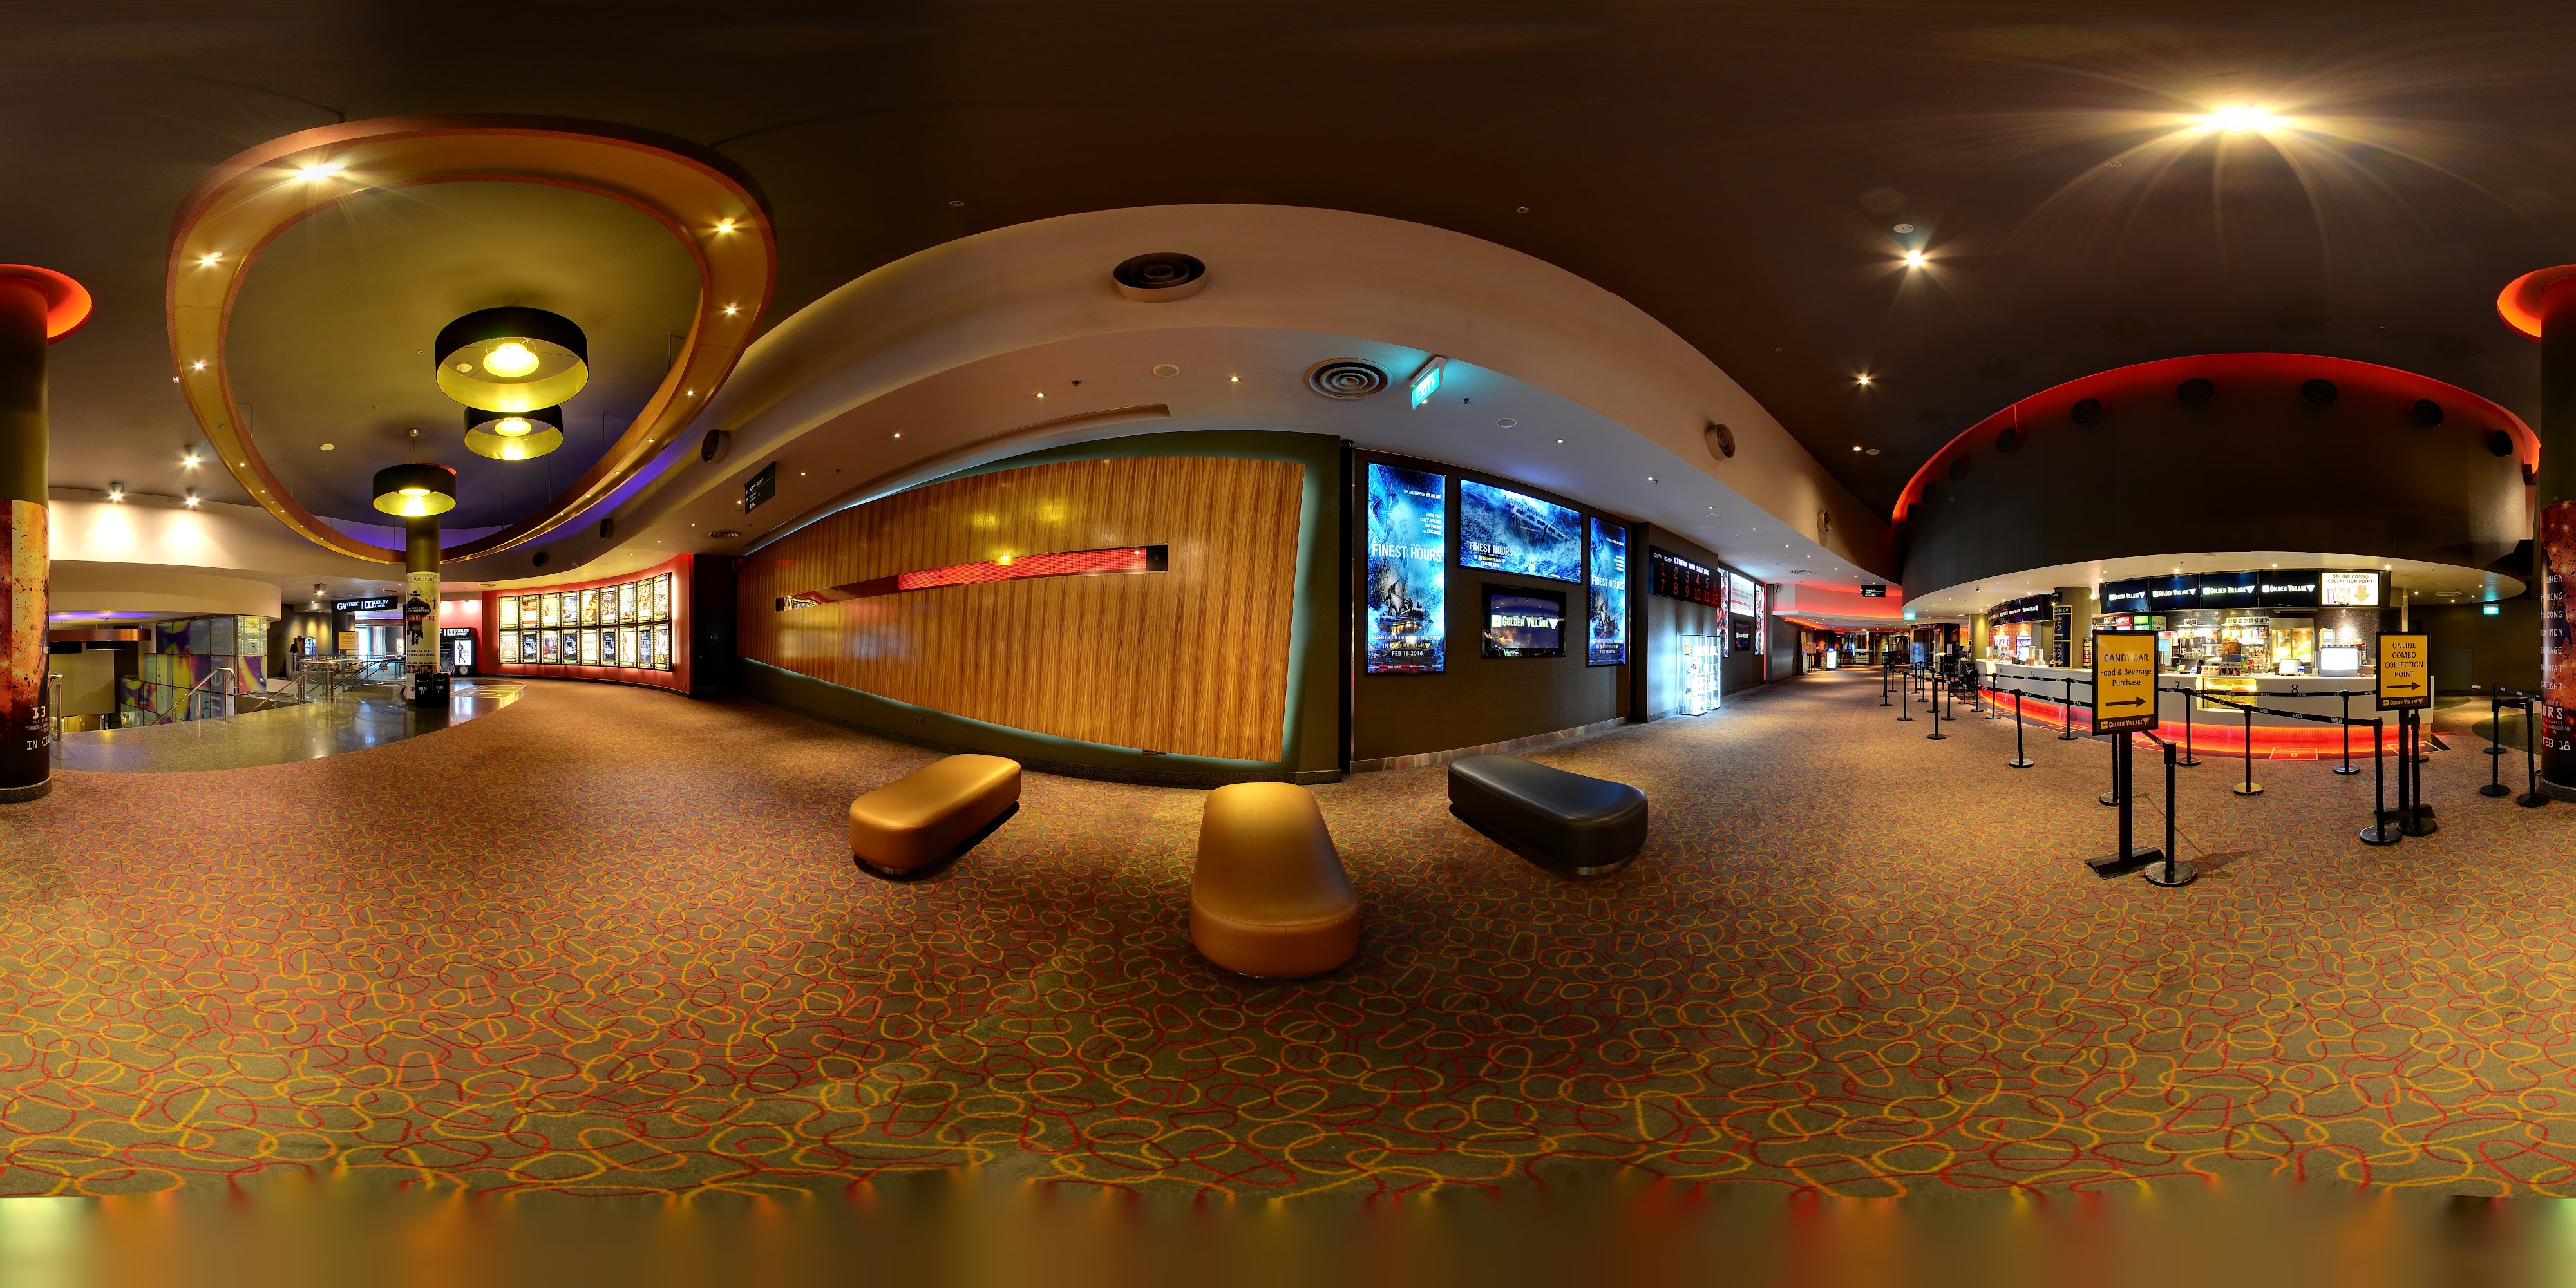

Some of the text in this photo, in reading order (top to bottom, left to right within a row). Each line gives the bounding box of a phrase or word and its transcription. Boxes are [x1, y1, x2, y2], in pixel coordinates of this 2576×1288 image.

[1416, 379, 1430, 402] EXIT
[1372, 543, 1442, 562] FINEST HOURS
[1470, 541, 1513, 556] FINEST HOURS
[1674, 557, 1687, 567] CINEMA
[1696, 565, 1710, 576] SEATING
[1592, 576, 1624, 591] FINEST HOURS
[1662, 563, 1717, 591] 1 2 3 4 5 6
[2547, 574, 2562, 583] WHEN
[1661, 579, 1718, 604] 7 8 9 10 11 12
[337, 601, 358, 610] GVmax
[1502, 616, 1549, 627] GOLDEN VILLAGE
[2543, 611, 2562, 619] WRONG
[2291, 684, 2298, 693] 8
[2544, 682, 2562, 690] RIGHT
[2543, 705, 2563, 719] URS
[27, 740, 38, 750] IN
[2543, 736, 2570, 750] FEB 18
